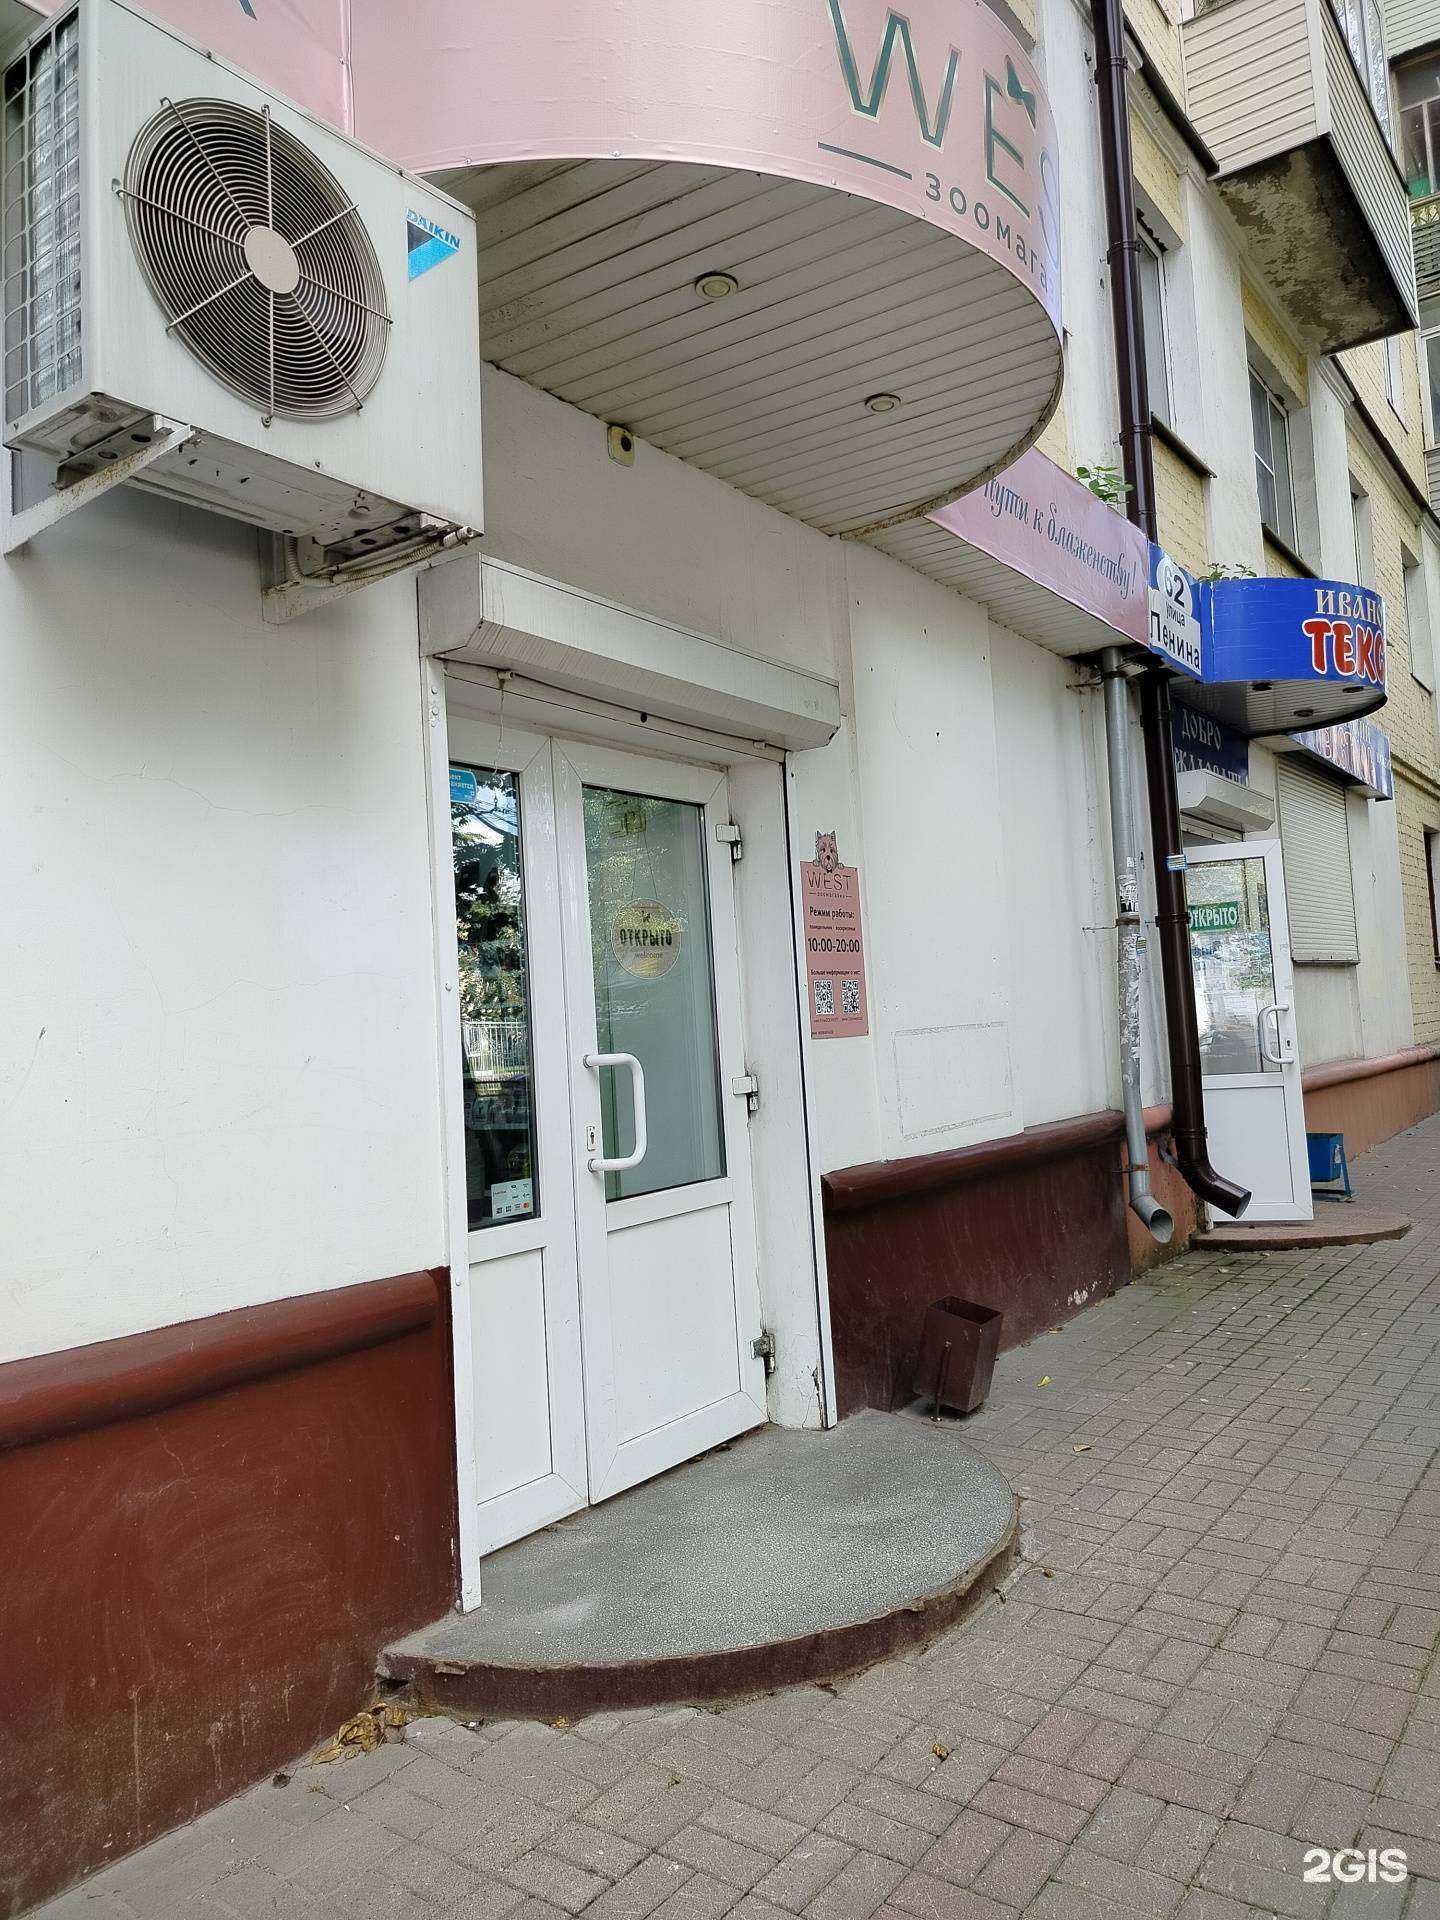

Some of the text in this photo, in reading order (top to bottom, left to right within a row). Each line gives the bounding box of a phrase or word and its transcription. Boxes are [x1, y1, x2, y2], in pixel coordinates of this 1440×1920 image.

[406, 208, 461, 249] DAIKIN
[1032, 508, 1044, 535] к
[1047, 502, 1137, 600] блаженству!
[1164, 565, 1185, 608] 62
[1165, 601, 1186, 628] улица
[1182, 708, 1222, 752] ДОБРО
[807, 870, 851, 891] WEST
[810, 905, 855, 921] Режим работы:
[620, 928, 673, 947] ОТКРЫТО
[807, 937, 861, 953] 10:00-20:00
[634, 950, 663, 960] welcome
